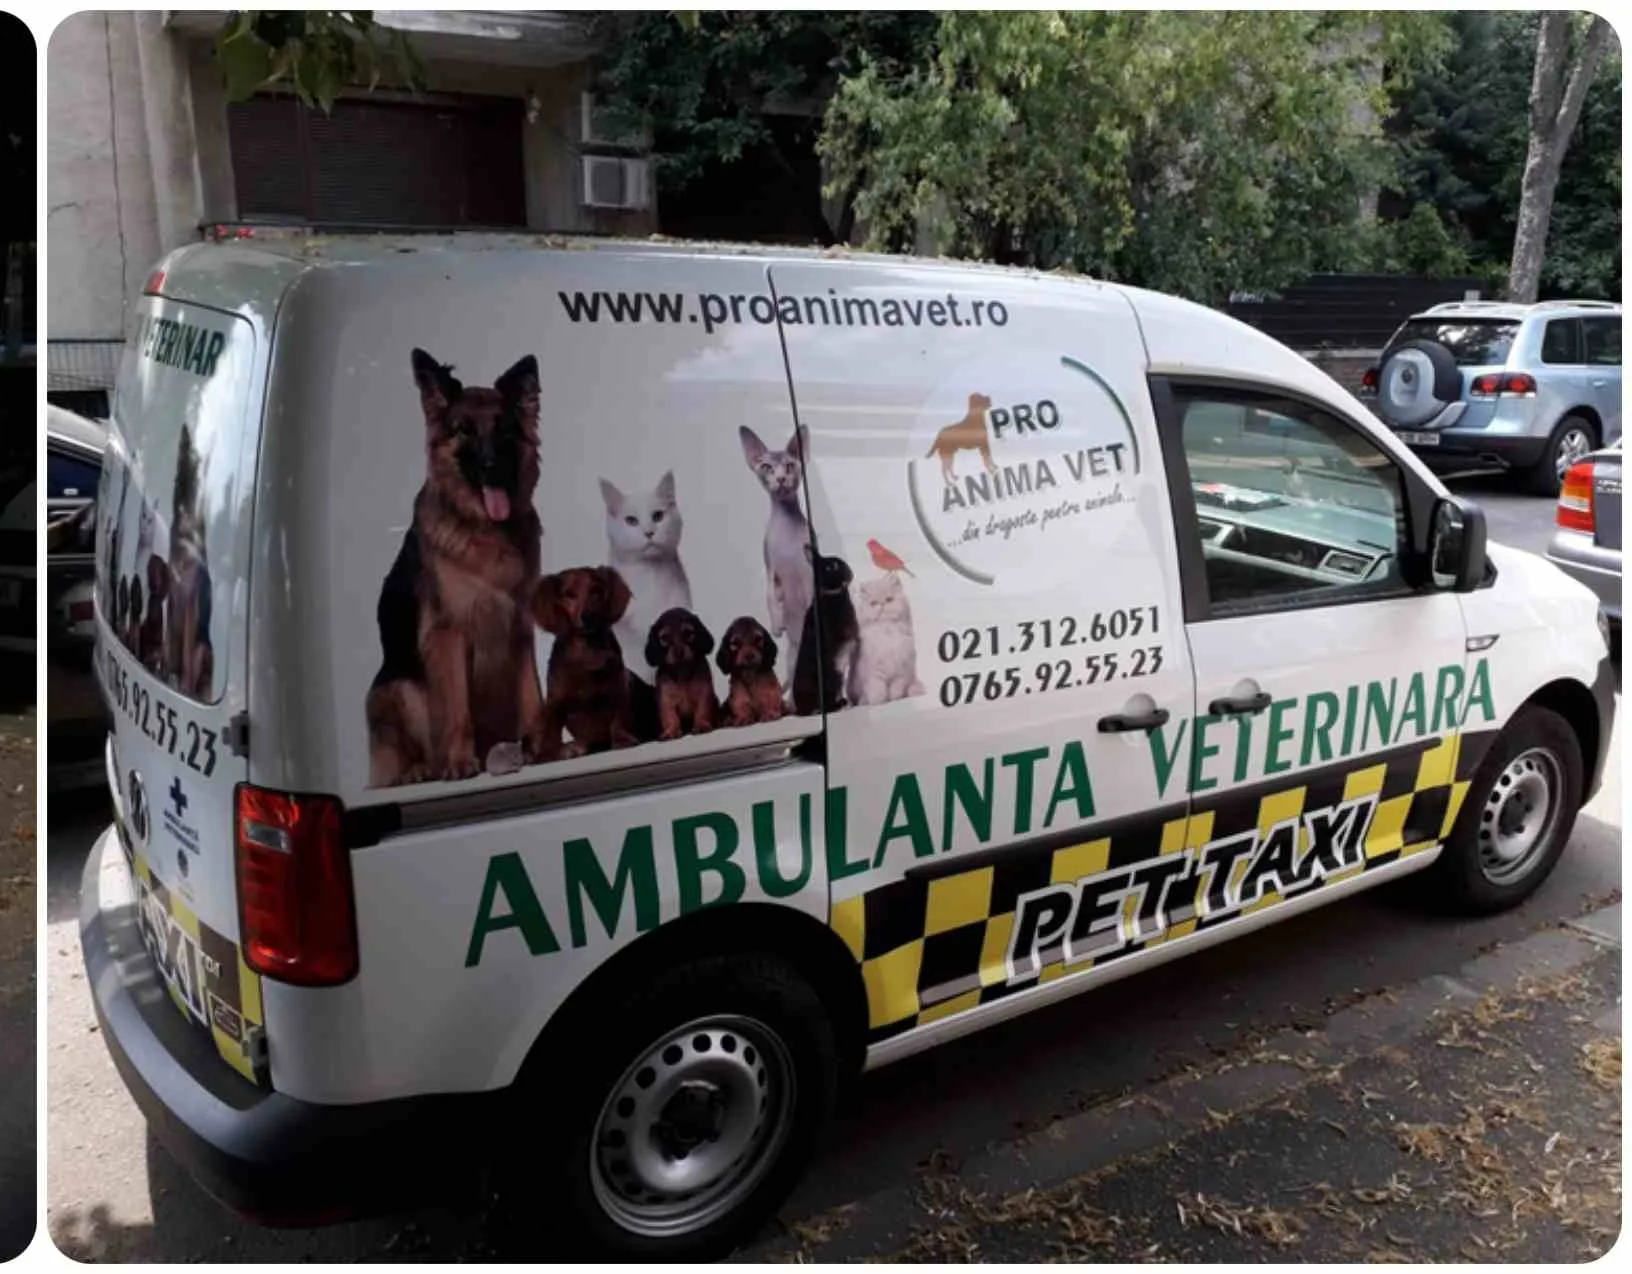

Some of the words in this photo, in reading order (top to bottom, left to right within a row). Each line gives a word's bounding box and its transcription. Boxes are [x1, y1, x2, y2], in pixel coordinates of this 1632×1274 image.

[558, 288, 1008, 334] www.proanimavet.ro
[990, 399, 1059, 439] PRO
[942, 459, 1057, 512] ANIMA
[1063, 443, 1125, 481] VET
[937, 605, 1159, 663] 021.312.6051
[939, 646, 1163, 708] 0765.92.55.23
[464, 740, 1098, 968] AMBULANTA
[1146, 658, 1496, 800] VETERINARA
[1006, 848, 1194, 987] PET
[1200, 793, 1380, 921] TAXI
